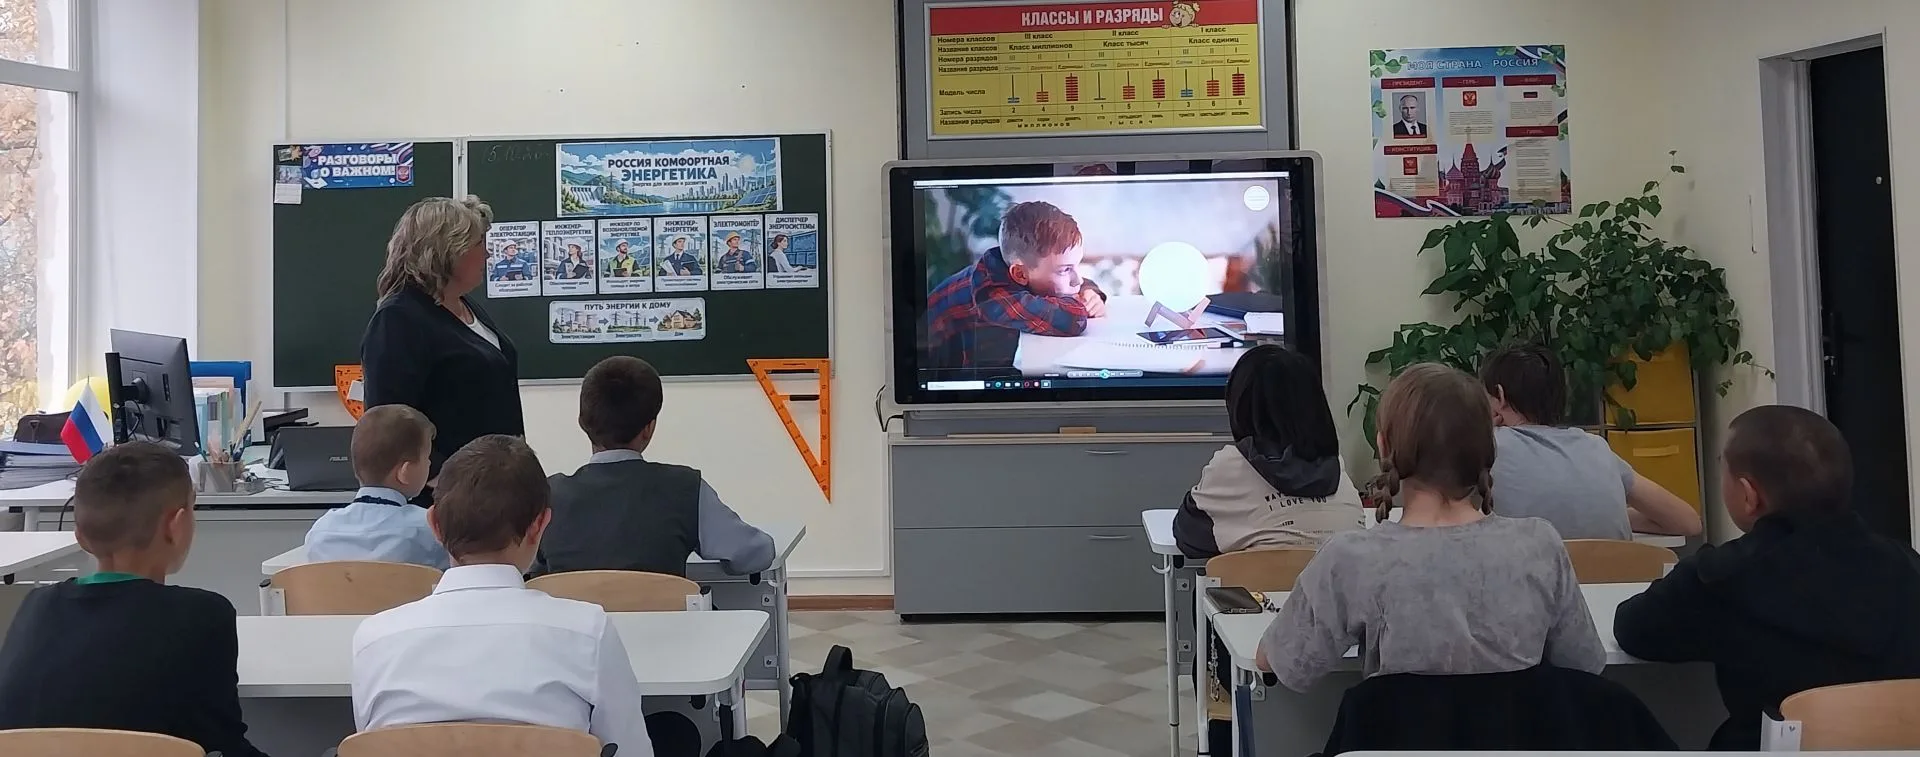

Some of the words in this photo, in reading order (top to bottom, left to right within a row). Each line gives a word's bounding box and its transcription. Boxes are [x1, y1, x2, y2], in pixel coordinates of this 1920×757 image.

[1021, 10, 1079, 26] КЛАССЫ
[1083, 9, 1092, 24] И
[1096, 7, 1163, 24] РАЗРЯДЫ
[1408, 61, 1433, 70] МОЯ
[1437, 60, 1482, 69] СТРАНА
[1493, 58, 1538, 67] РОССИЯ
[318, 154, 397, 166] РАЗГОВОРЫ
[608, 158, 651, 168] РОССИЯ
[655, 156, 729, 167] КОМФОРТНАЯ
[320, 167, 330, 177] О
[332, 165, 395, 177] ВАЖНОМ!
[621, 167, 717, 181] ЭНЕРГЕТИКА
[606, 302, 640, 310] ЭНЕРГИИ
[1280, 497, 1304, 508] LOVE
[1311, 495, 1327, 503] YOU
